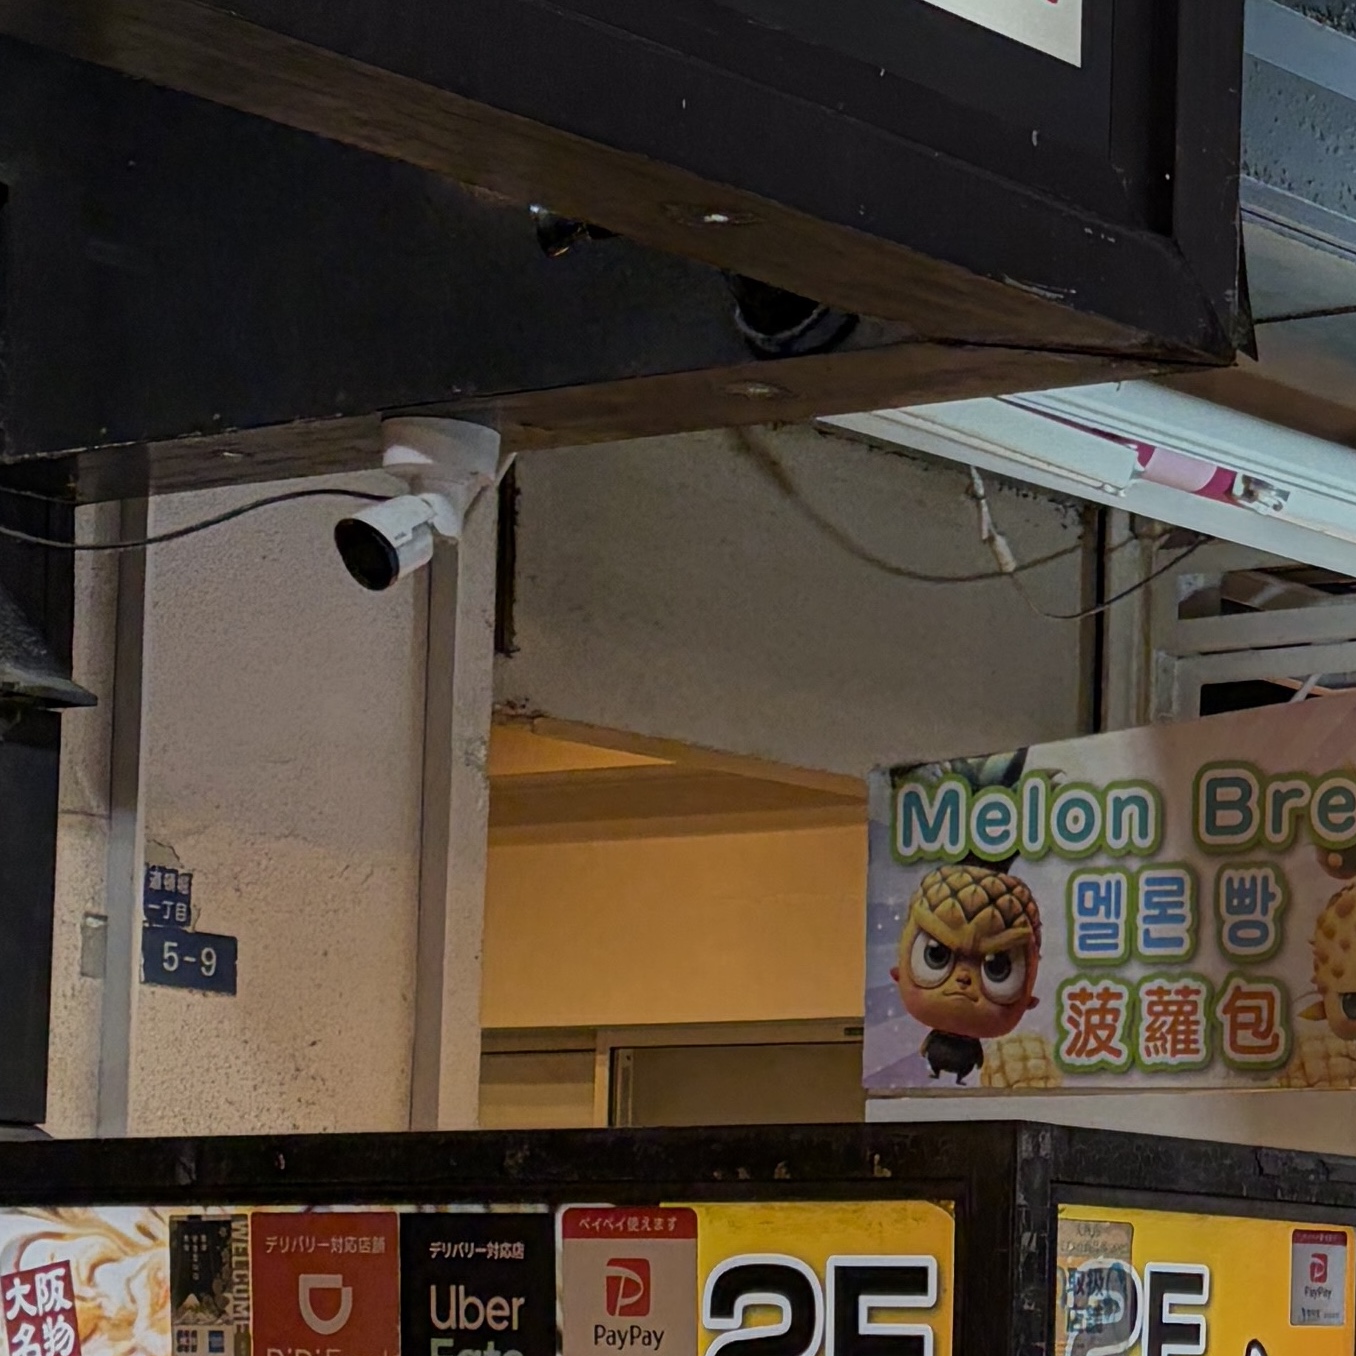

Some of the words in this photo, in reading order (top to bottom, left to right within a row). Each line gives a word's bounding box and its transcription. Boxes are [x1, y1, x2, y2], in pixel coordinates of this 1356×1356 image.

[897, 769, 1160, 858] Melon
[162, 940, 217, 977] 5-9
[1064, 983, 1284, 1066] 菠蘿包
[578, 1217, 678, 1232] ペイペイ使えます
[265, 1236, 386, 1254] デリバリー対応店舗
[429, 1241, 525, 1260] デリバリー対応店
[5, 1268, 73, 1319] 大阪
[429, 1284, 526, 1331] Uber
[1303, 1286, 1333, 1299] PayPay
[593, 1324, 665, 1350] PayPay
